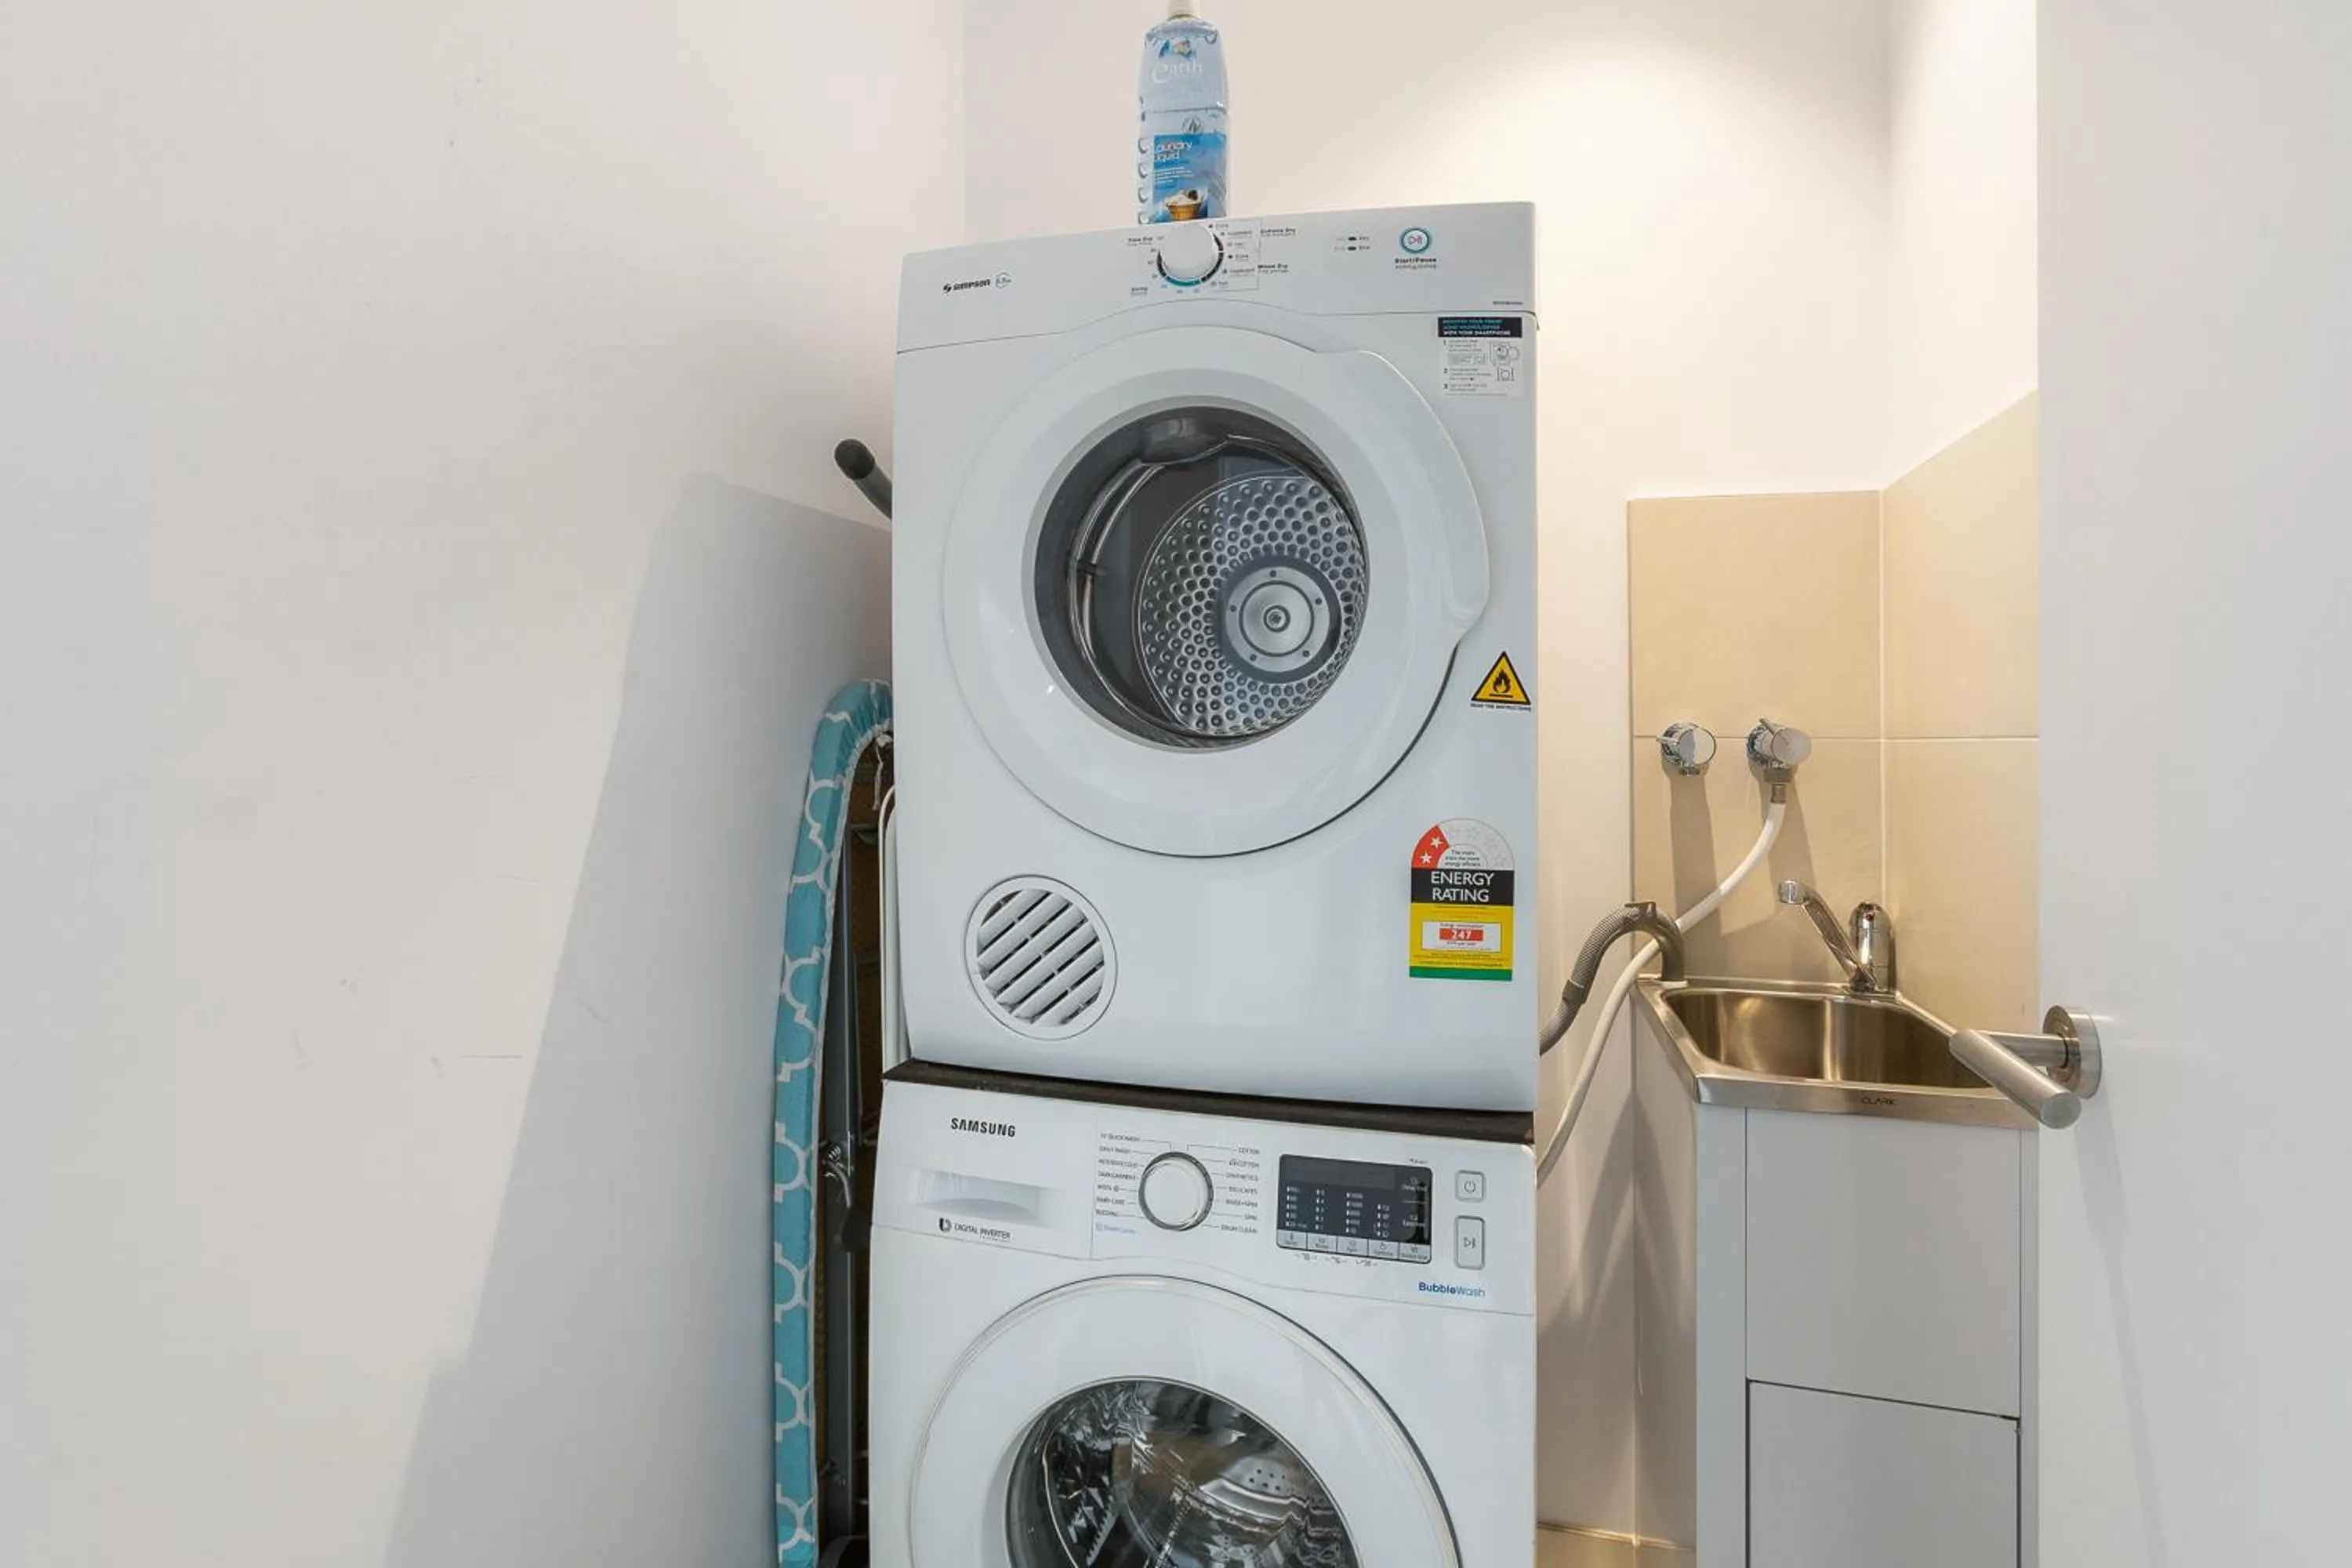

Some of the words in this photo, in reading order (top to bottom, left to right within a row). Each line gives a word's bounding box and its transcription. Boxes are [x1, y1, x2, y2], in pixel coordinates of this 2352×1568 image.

[1431, 871, 1494, 886] ENERGY
[1432, 887, 1490, 902] RATING
[1451, 928, 1472, 940] 247
[951, 1117, 1016, 1137] SAMSUNG
[954, 1222, 978, 1235] DIGITAL
[980, 1227, 1011, 1240] INVERTER
[1418, 1282, 1486, 1298] BubbleWash
